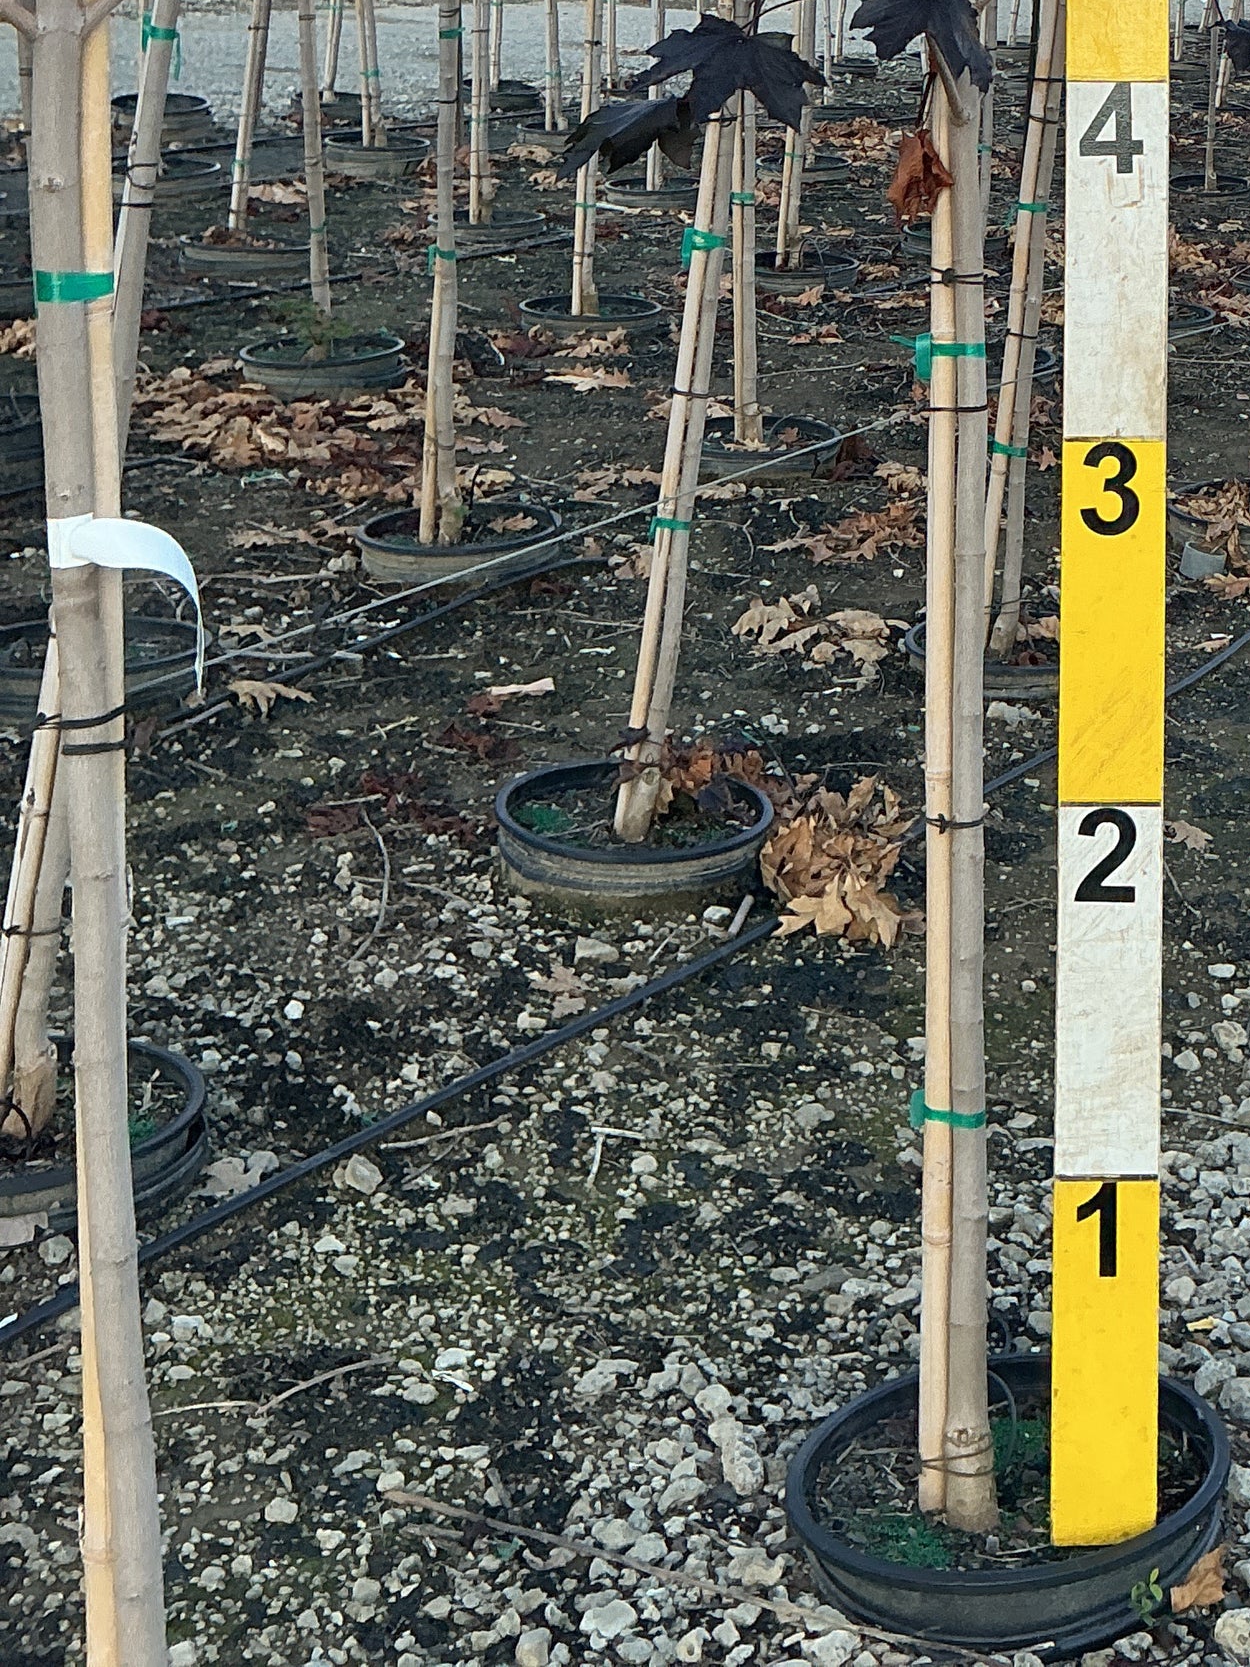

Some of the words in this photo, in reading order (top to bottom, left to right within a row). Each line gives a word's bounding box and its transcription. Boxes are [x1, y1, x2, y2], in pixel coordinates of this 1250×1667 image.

[1079, 82, 1143, 174] 4
[1080, 442, 1140, 536] 3
[1074, 808, 1137, 903] 2
[1076, 1182, 1117, 1277] 1
